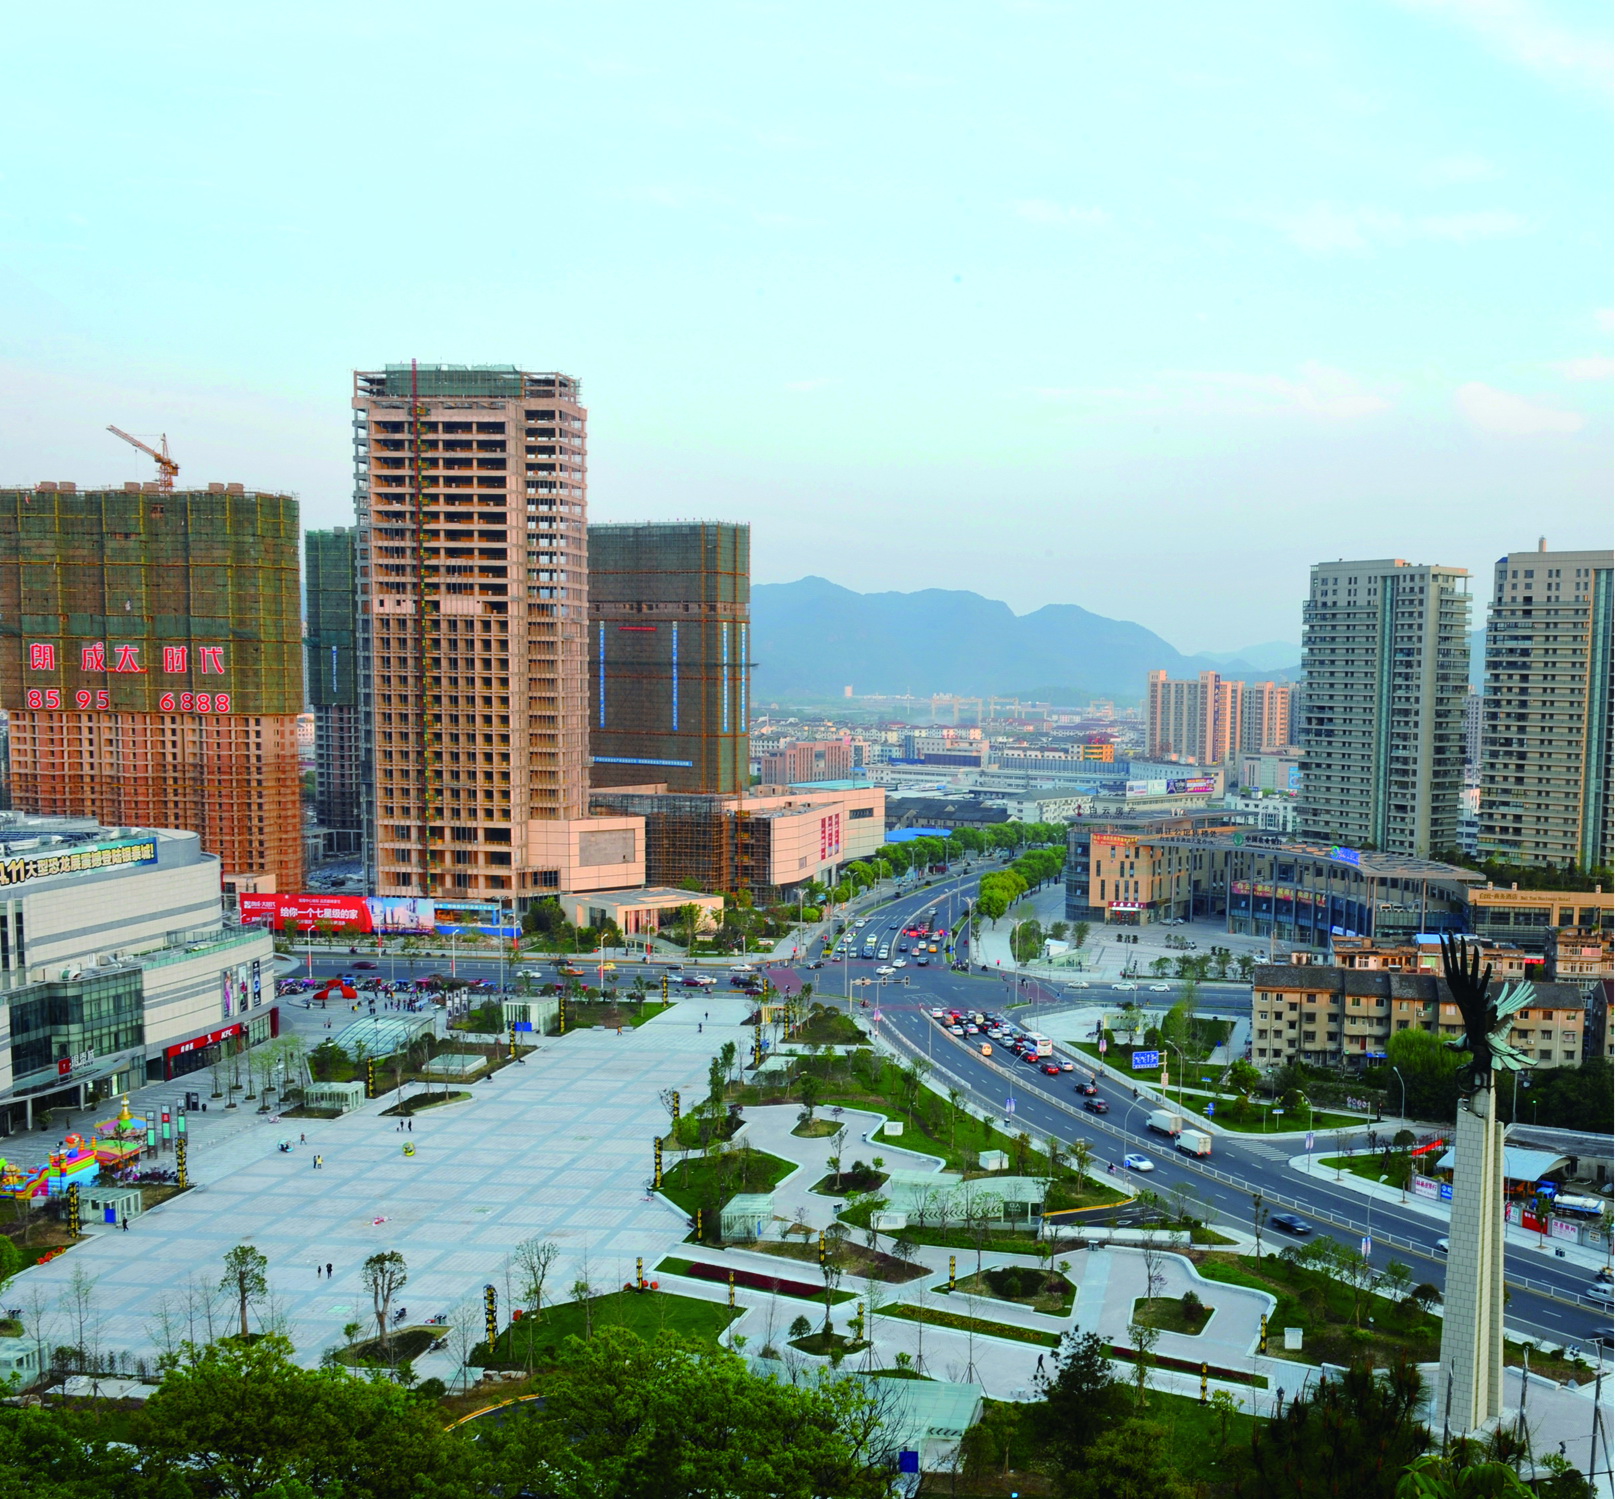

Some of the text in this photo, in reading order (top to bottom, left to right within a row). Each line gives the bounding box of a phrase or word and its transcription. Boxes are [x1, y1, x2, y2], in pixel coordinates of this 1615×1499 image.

[29, 642, 225, 675] 朗成大时代
[159, 691, 231, 713] 6888
[1089, 805, 1137, 816] 白云房产
[280, 907, 358, 919] 给你一个七星级的家
[220, 1028, 233, 1040] KFC
